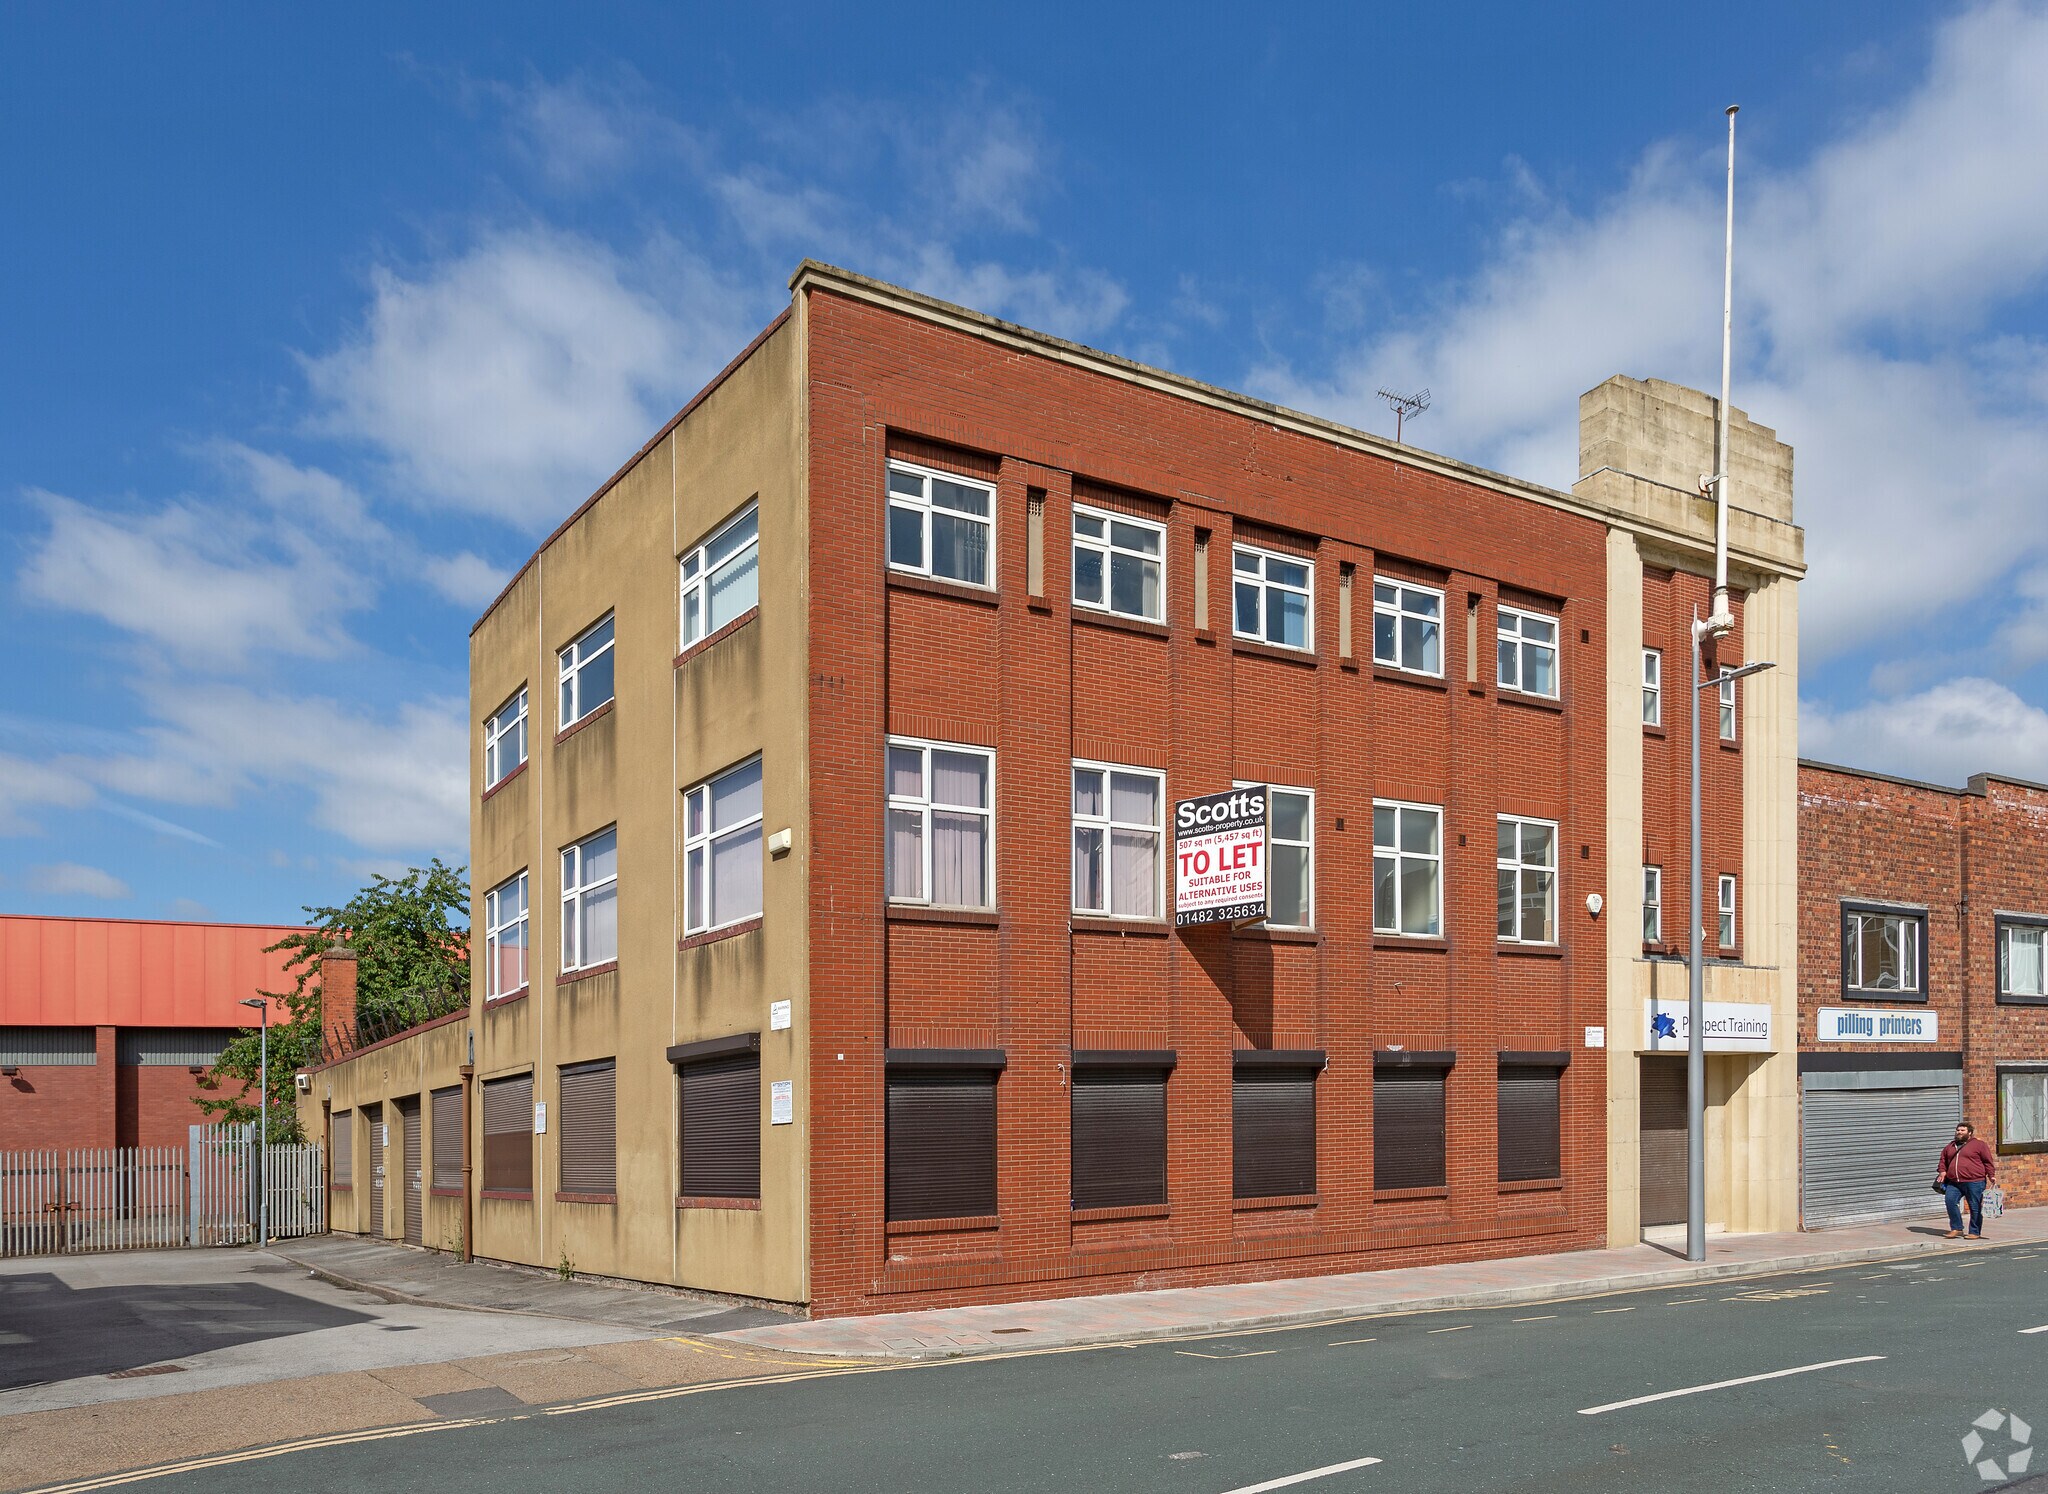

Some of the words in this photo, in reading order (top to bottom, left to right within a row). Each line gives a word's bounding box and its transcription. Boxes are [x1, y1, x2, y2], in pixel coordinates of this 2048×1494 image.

[1177, 792, 1265, 828] Scotts
[1178, 816, 1264, 837] www.scotts-property.co.uk
[1179, 839, 1193, 850] 507
[1194, 840, 1203, 848] sq
[1204, 837, 1212, 845] m
[1214, 832, 1239, 845] (5,457
[1241, 831, 1250, 841] sq
[1252, 828, 1263, 838] ft)
[1179, 850, 1210, 877] TO
[1219, 841, 1263, 872] LET
[1188, 873, 1231, 887] SUITABLE
[1233, 871, 1251, 881] FOR
[1178, 883, 1237, 901] ALTERNATIVE
[1239, 881, 1263, 893] USES
[1178, 901, 1197, 909] subject
[1204, 898, 1214, 906] any
[1215, 895, 1238, 905] required
[1238, 892, 1264, 900] consents
[1176, 909, 1213, 925] 01482
[1218, 903, 1265, 920] 325634
[1682, 1016, 1727, 1034] Ppect
[1728, 1018, 1768, 1036] Training
[1837, 1013, 1873, 1036] pilling
[1879, 1015, 1922, 1036] printers
